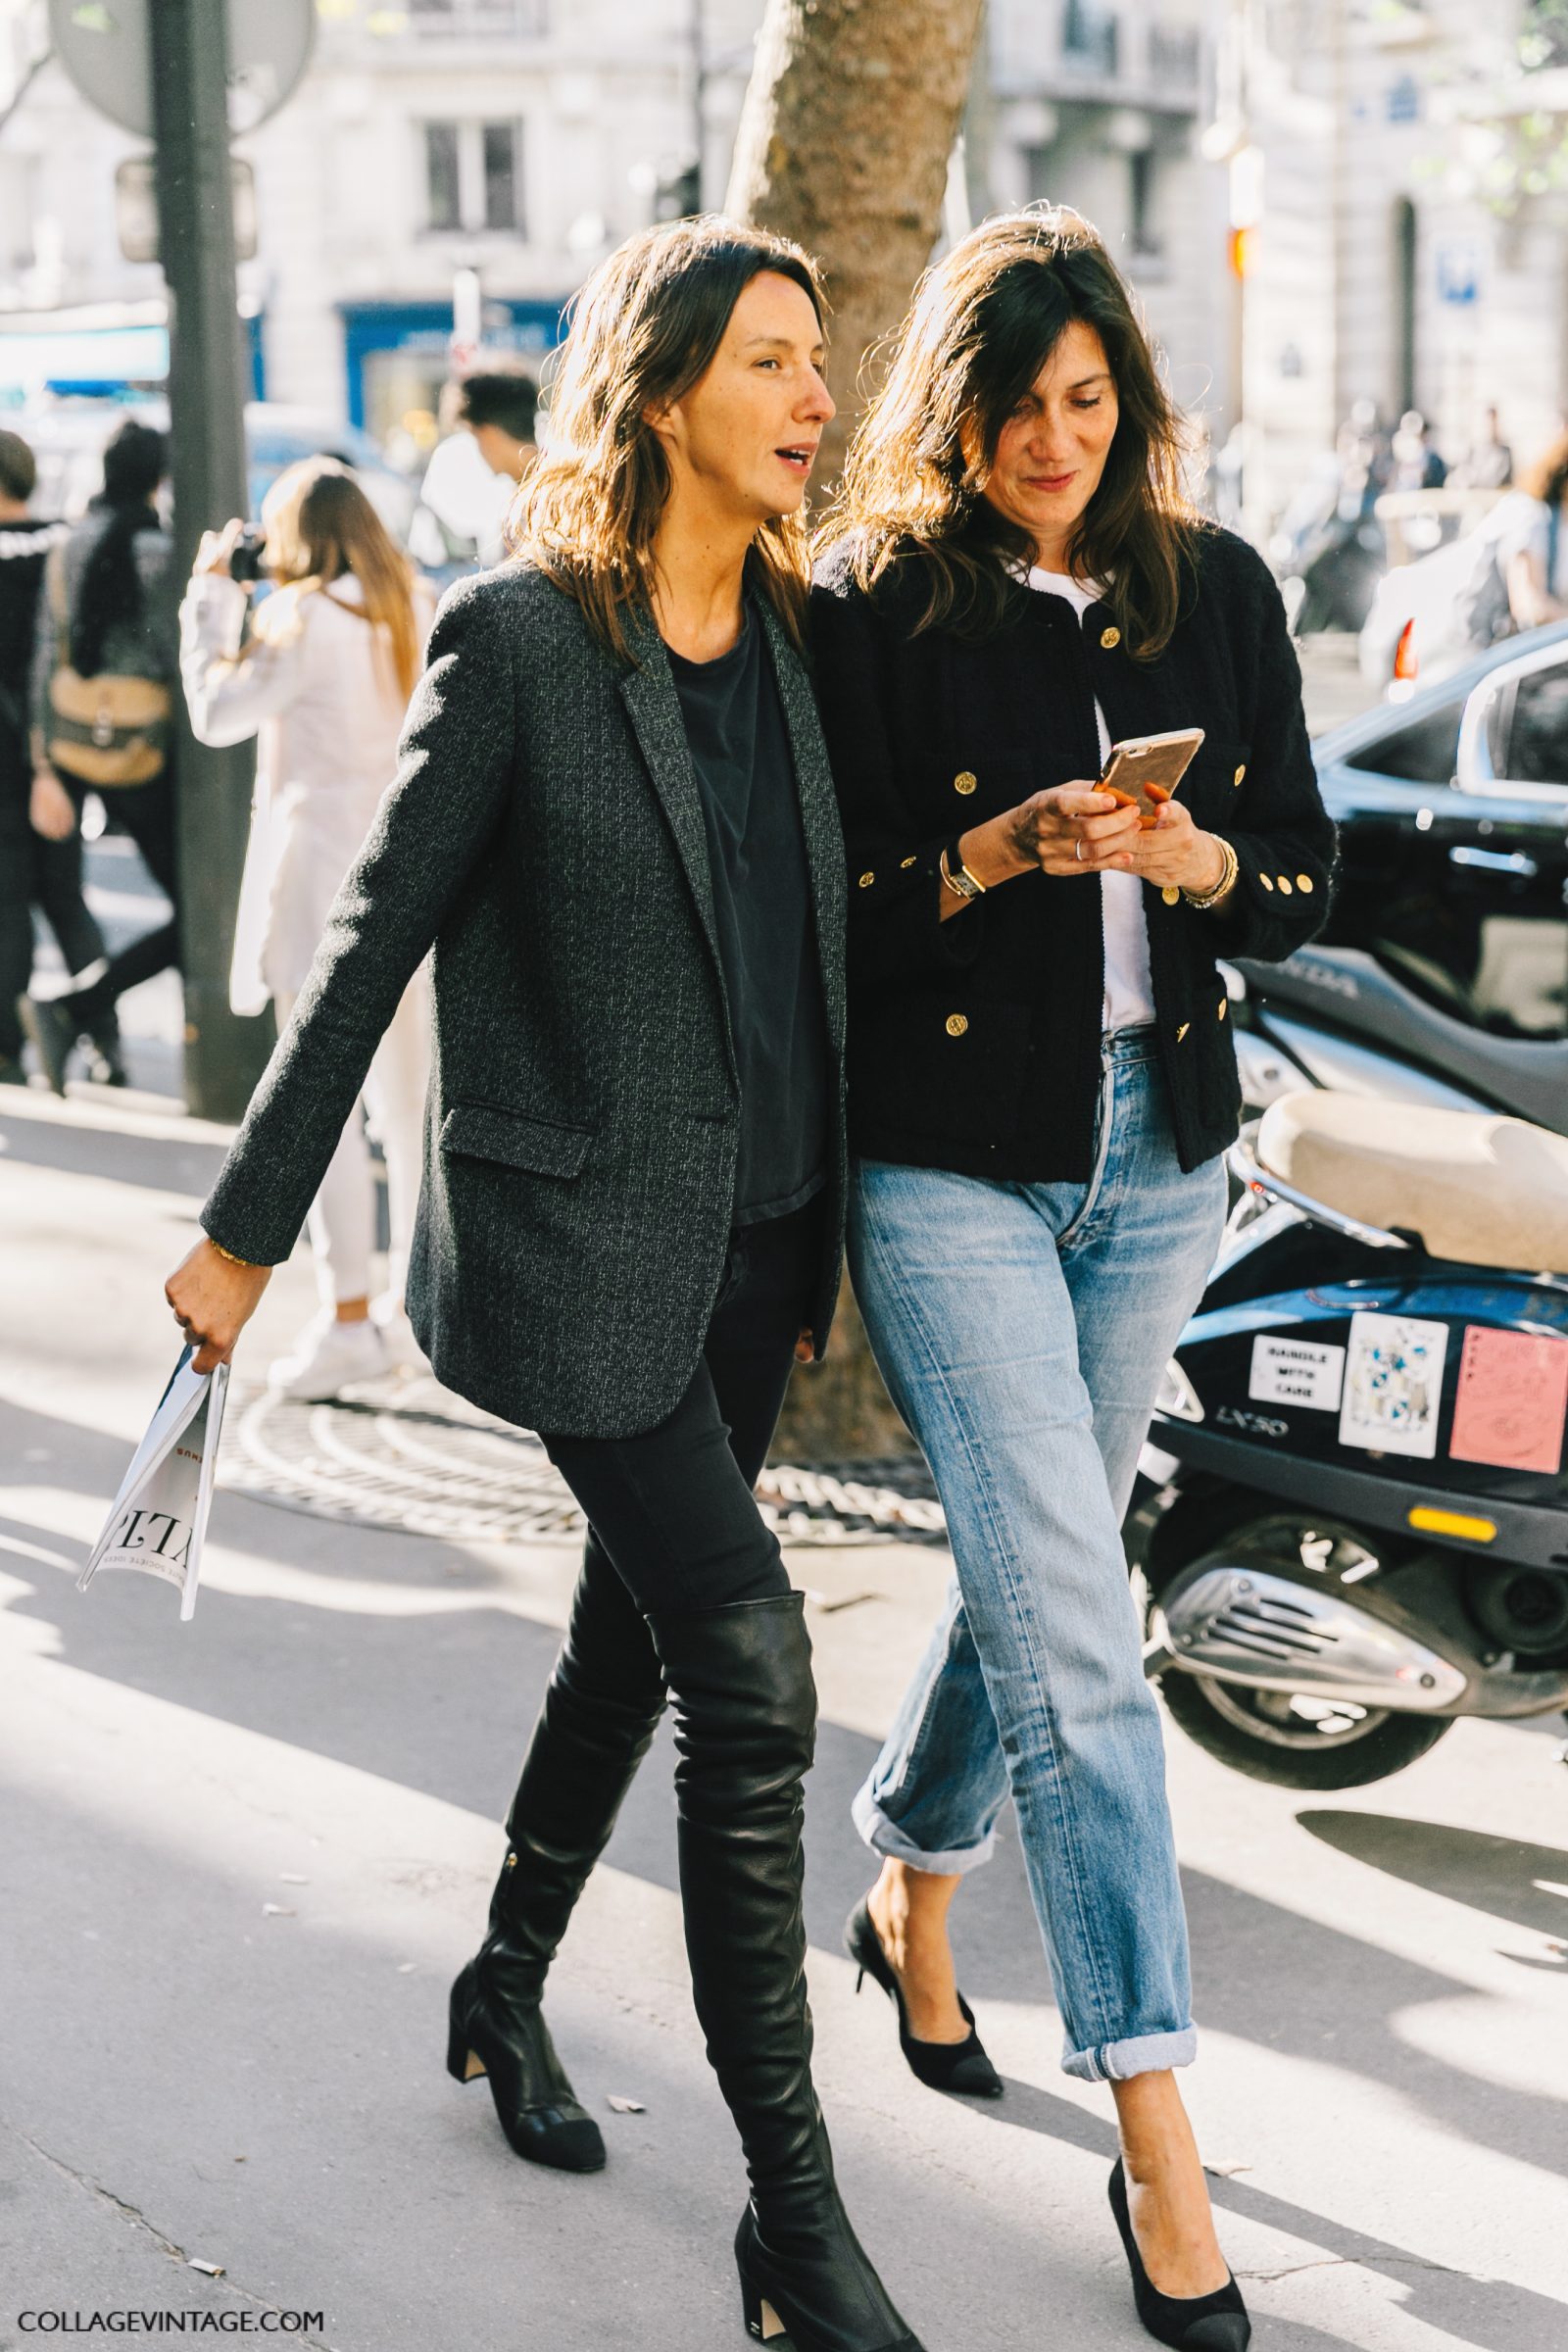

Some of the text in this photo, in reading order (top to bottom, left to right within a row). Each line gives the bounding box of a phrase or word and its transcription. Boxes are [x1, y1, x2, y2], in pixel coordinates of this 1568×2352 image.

[1267, 1347, 1328, 1364] HANDLE
[1277, 1366, 1315, 1380] WITH
[1275, 1383, 1313, 1398] CARE
[1216, 1404, 1290, 1438] LX50
